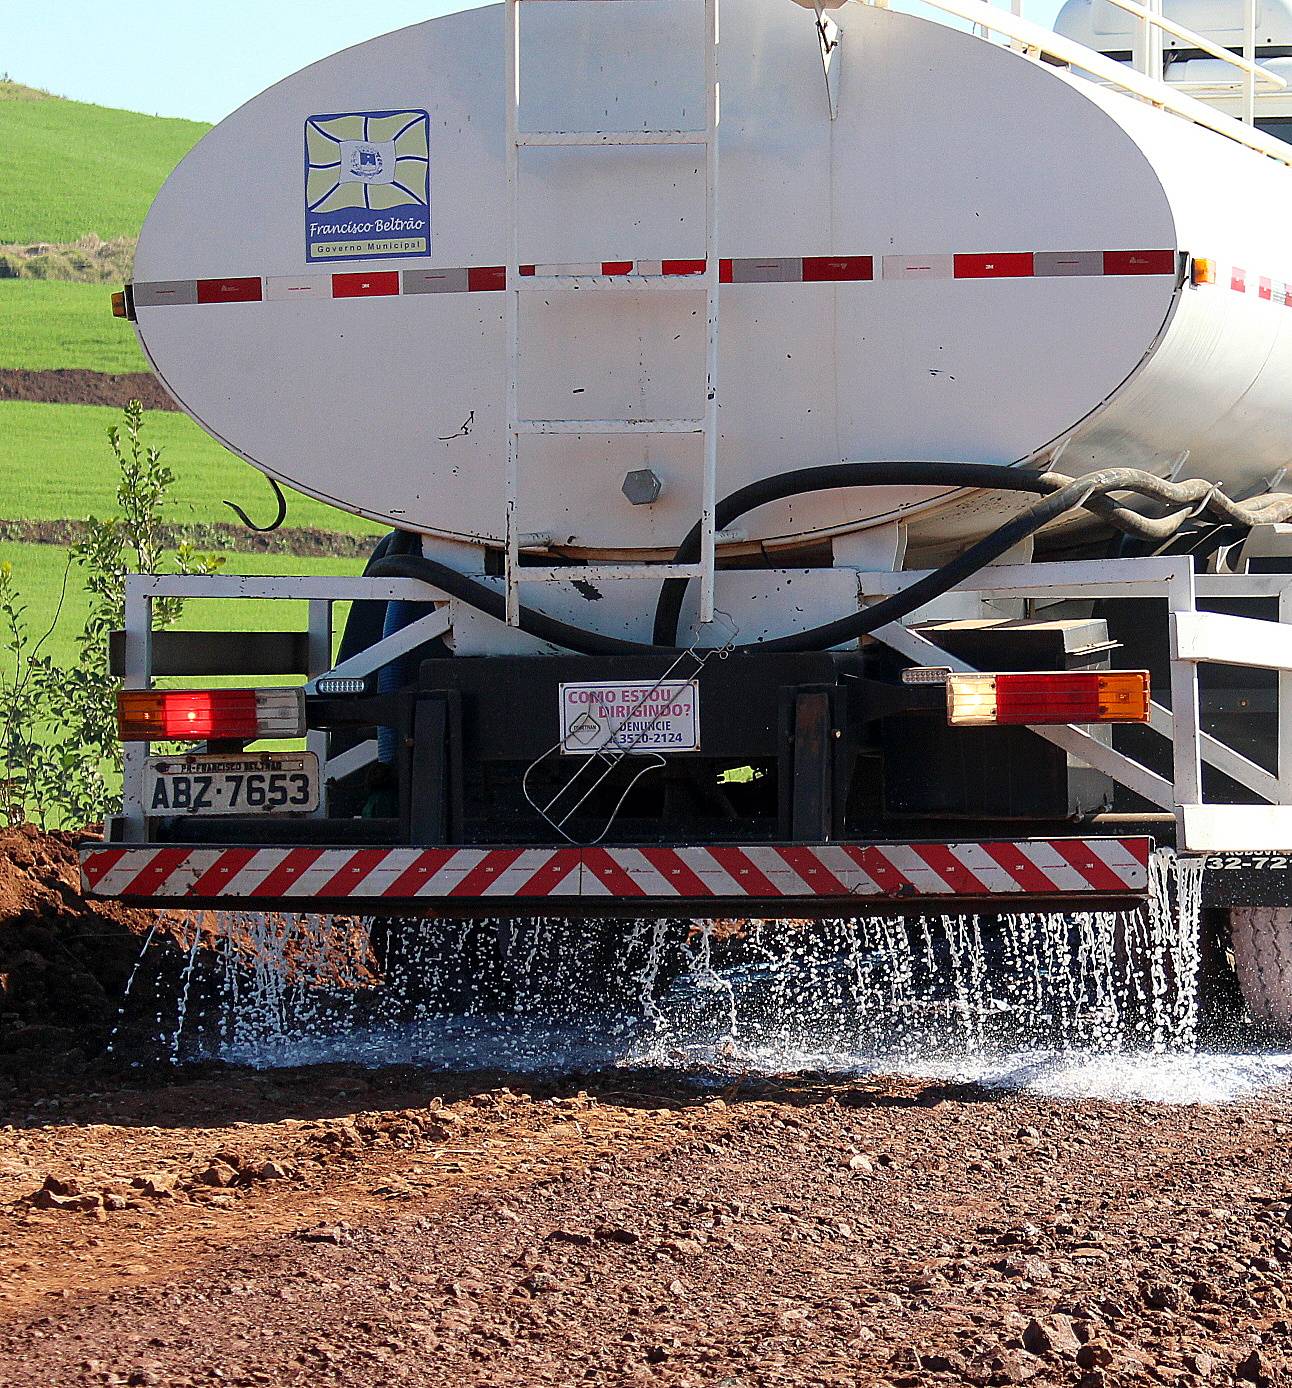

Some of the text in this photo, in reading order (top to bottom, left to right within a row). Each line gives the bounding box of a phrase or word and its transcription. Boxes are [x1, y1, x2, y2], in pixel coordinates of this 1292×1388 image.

[309, 217, 425, 237] Francisco Beltrão
[317, 241, 421, 253] Governo Municipal
[568, 689, 671, 704] COMO ESTOU
[598, 704, 691, 718] DIRIGINDO?
[619, 721, 671, 732] DENUNCIE
